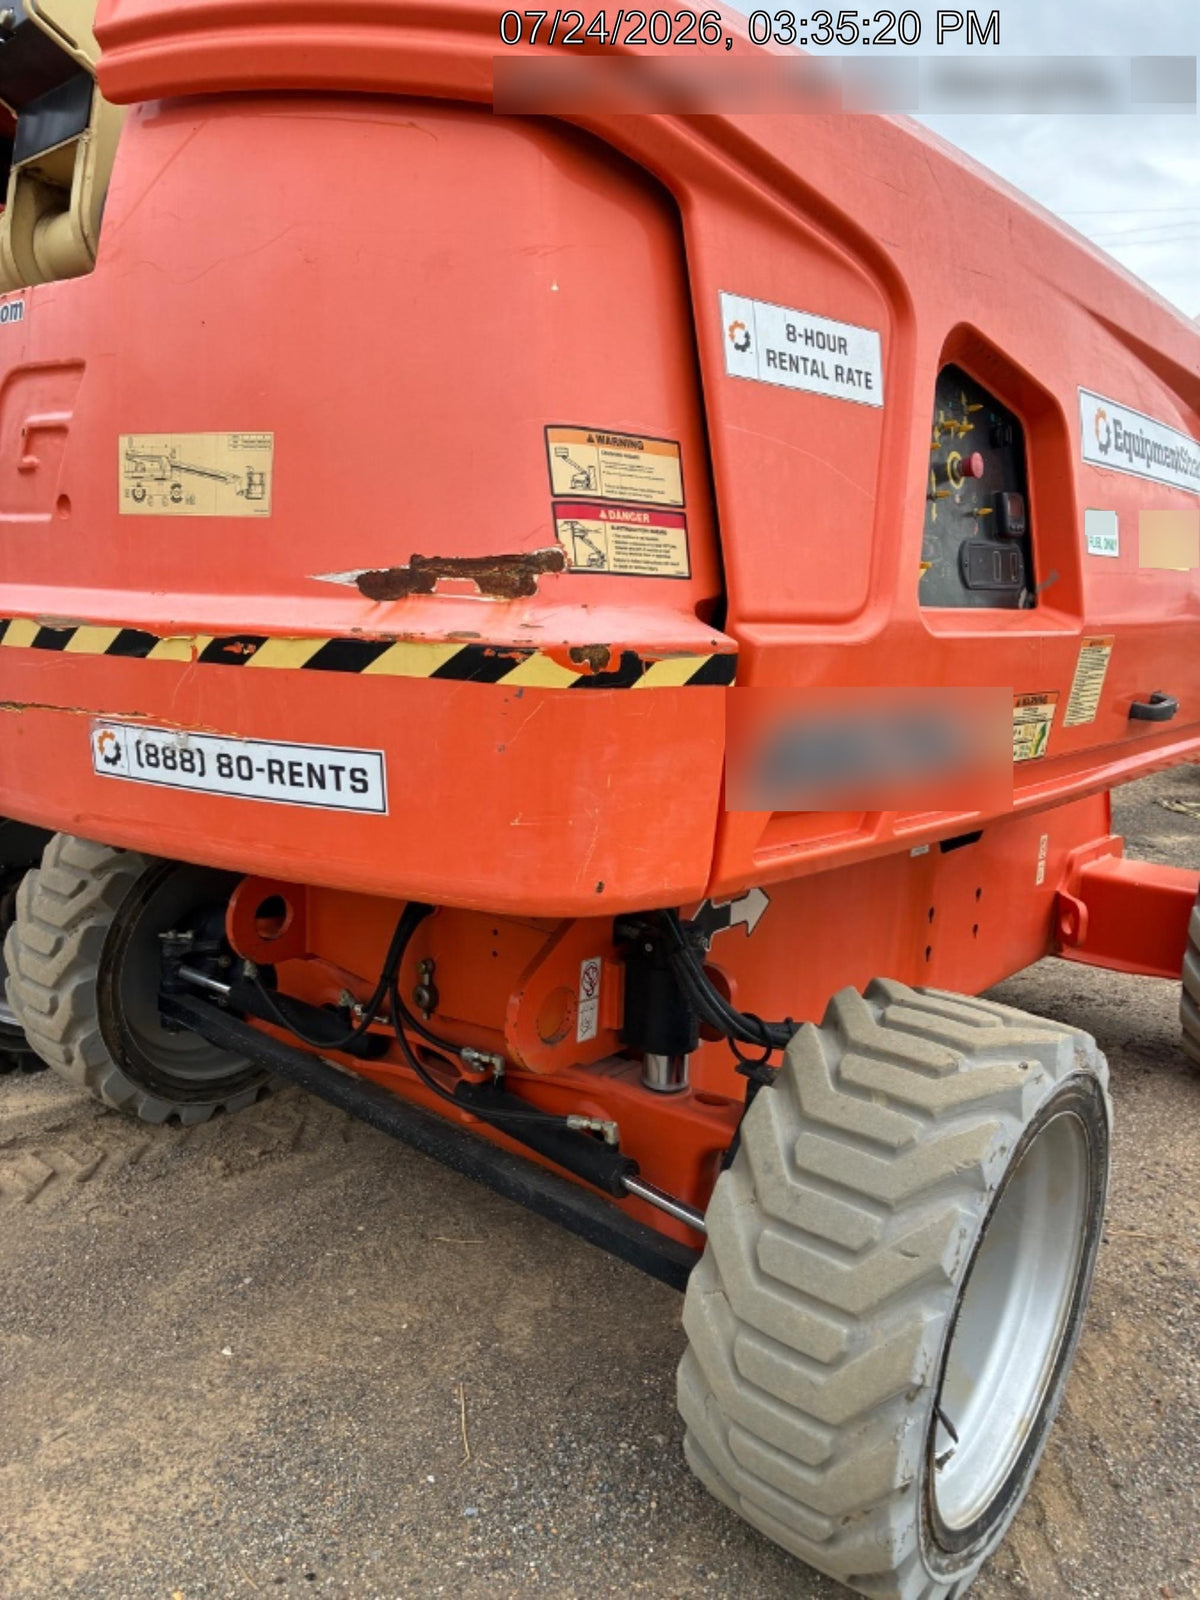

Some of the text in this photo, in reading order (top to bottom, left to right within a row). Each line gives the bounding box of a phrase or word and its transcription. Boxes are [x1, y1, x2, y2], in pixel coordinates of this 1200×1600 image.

[785, 323, 848, 356] 8-HOUR
[766, 348, 873, 390] RENTAL RATE
[596, 434, 644, 450] WARNING
[609, 510, 650, 524] DANGER
[135, 739, 369, 794] (888) 80-RENTS
